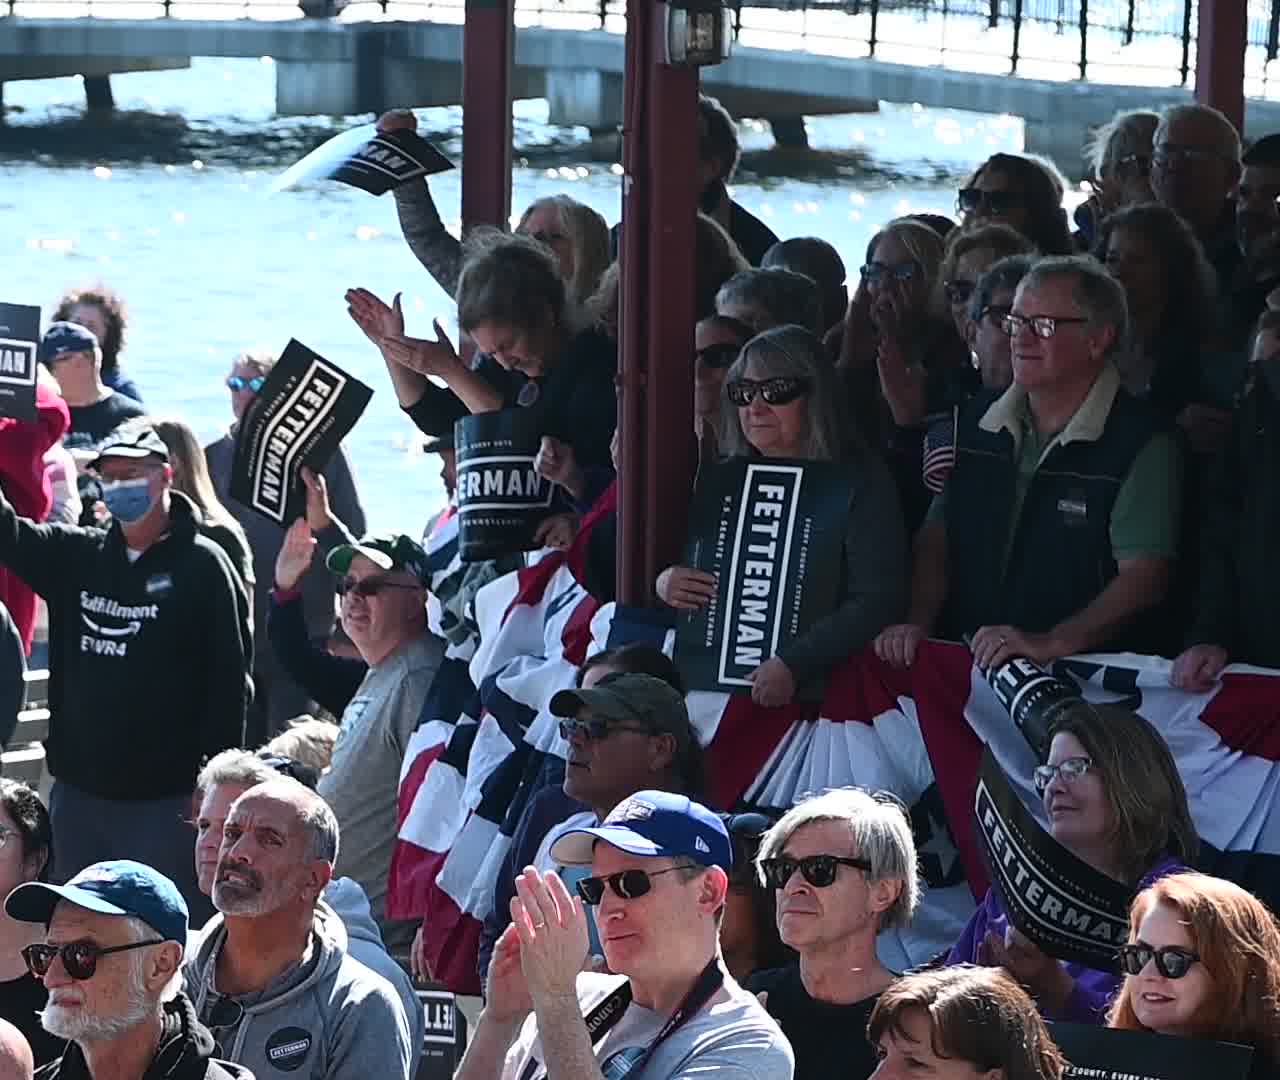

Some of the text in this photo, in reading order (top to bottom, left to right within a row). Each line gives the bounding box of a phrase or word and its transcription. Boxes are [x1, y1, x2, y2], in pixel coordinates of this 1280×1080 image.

[262, 378, 332, 503] FETTERMAN
[458, 469, 541, 500] ERMAN
[734, 484, 785, 666] FETTERMAN
[984, 808, 1126, 942] FETTERMA
